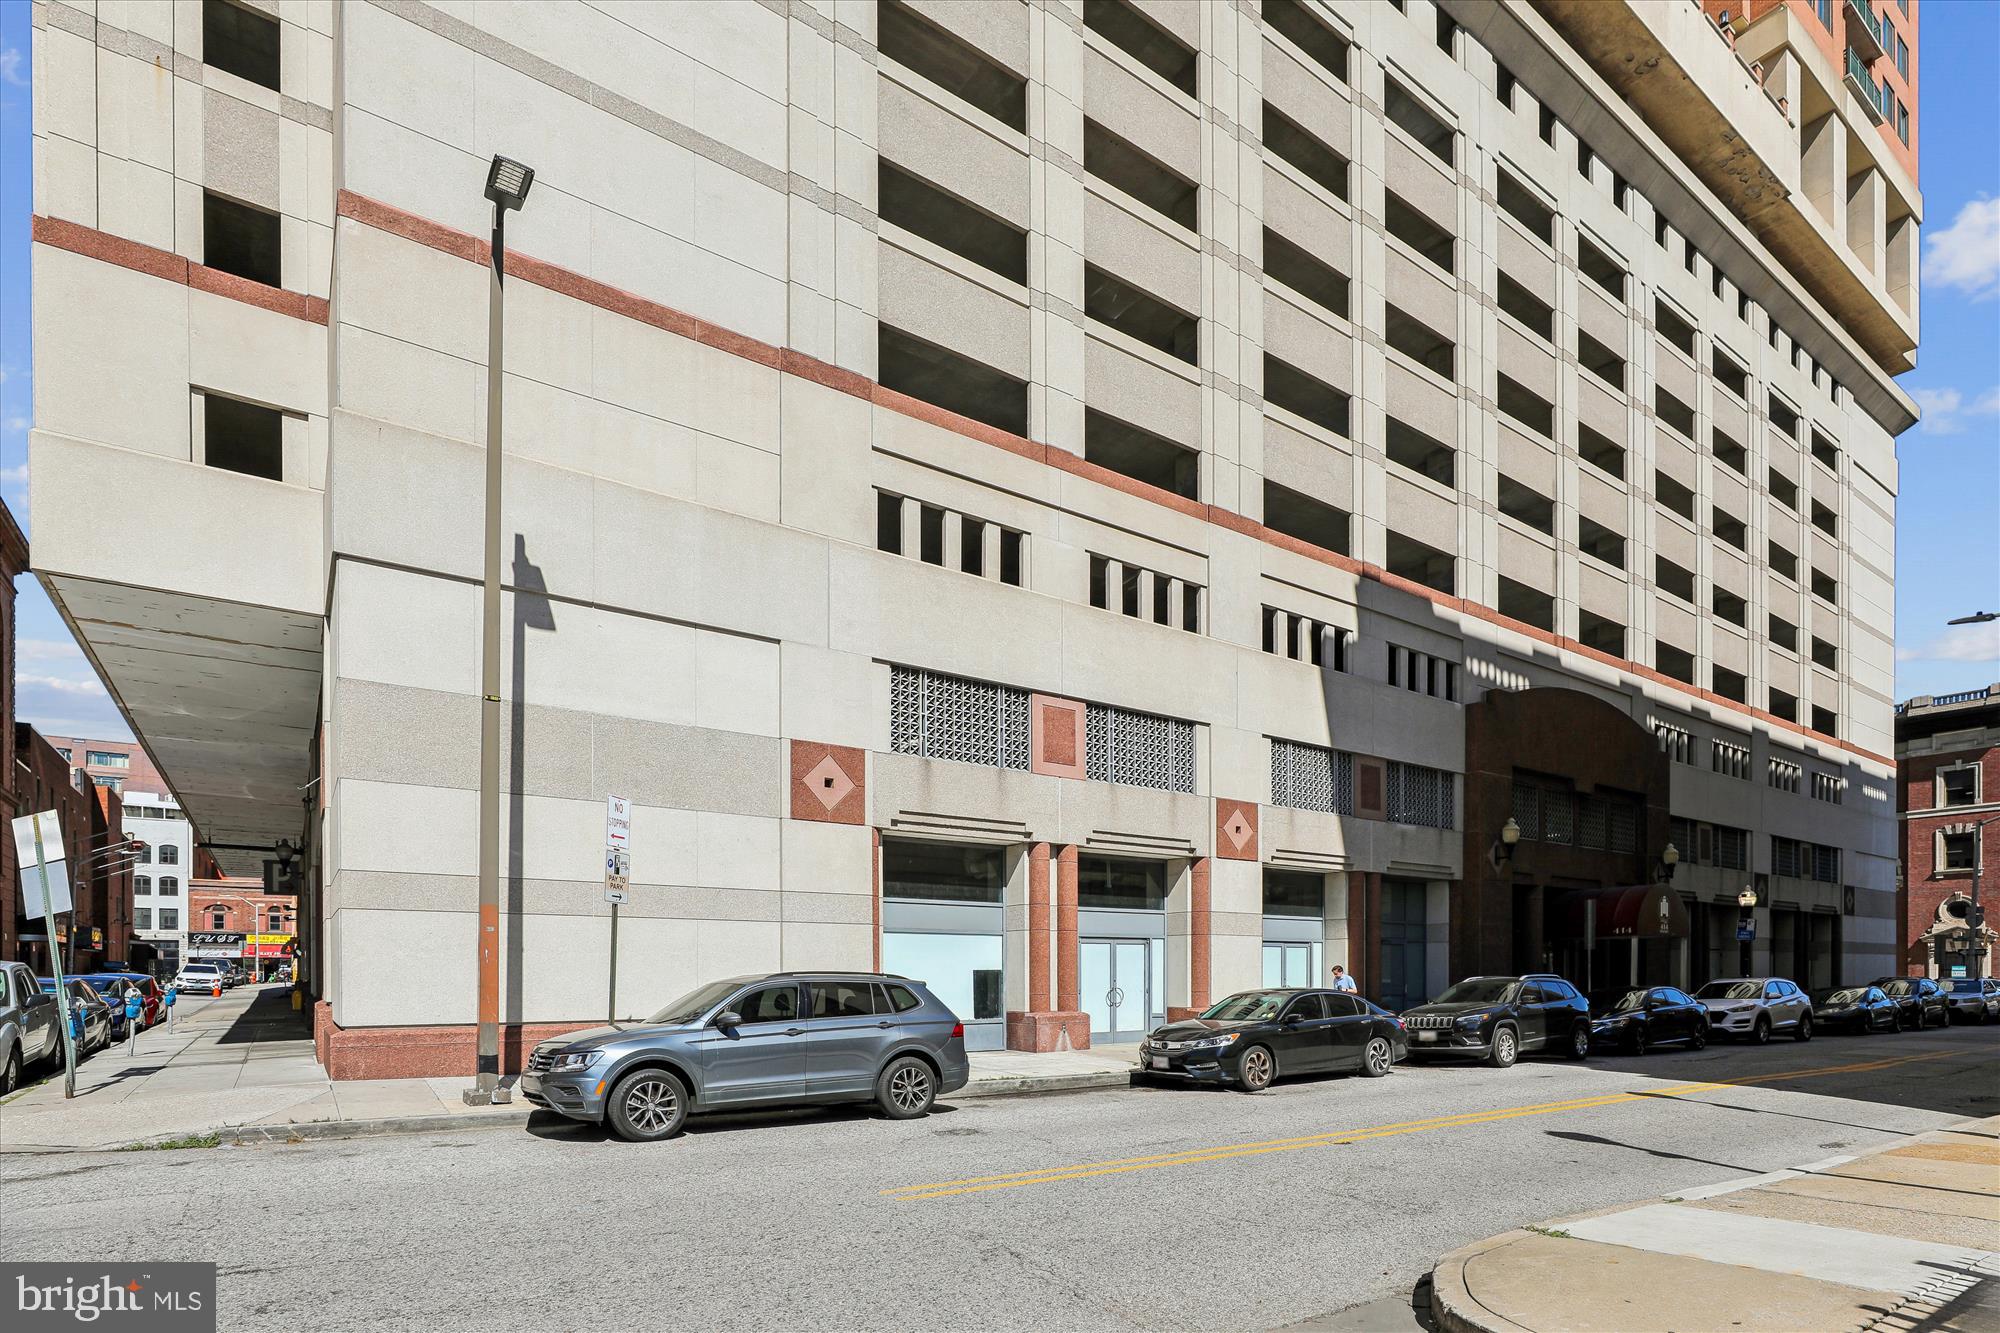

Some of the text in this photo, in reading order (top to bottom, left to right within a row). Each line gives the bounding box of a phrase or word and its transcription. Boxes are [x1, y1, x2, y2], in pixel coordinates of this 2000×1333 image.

[615, 802, 624, 813] NO
[608, 817, 628, 830] STOPPING
[273, 864, 291, 892] P
[610, 883, 624, 891] PARK
[191, 934, 240, 944] LUST
